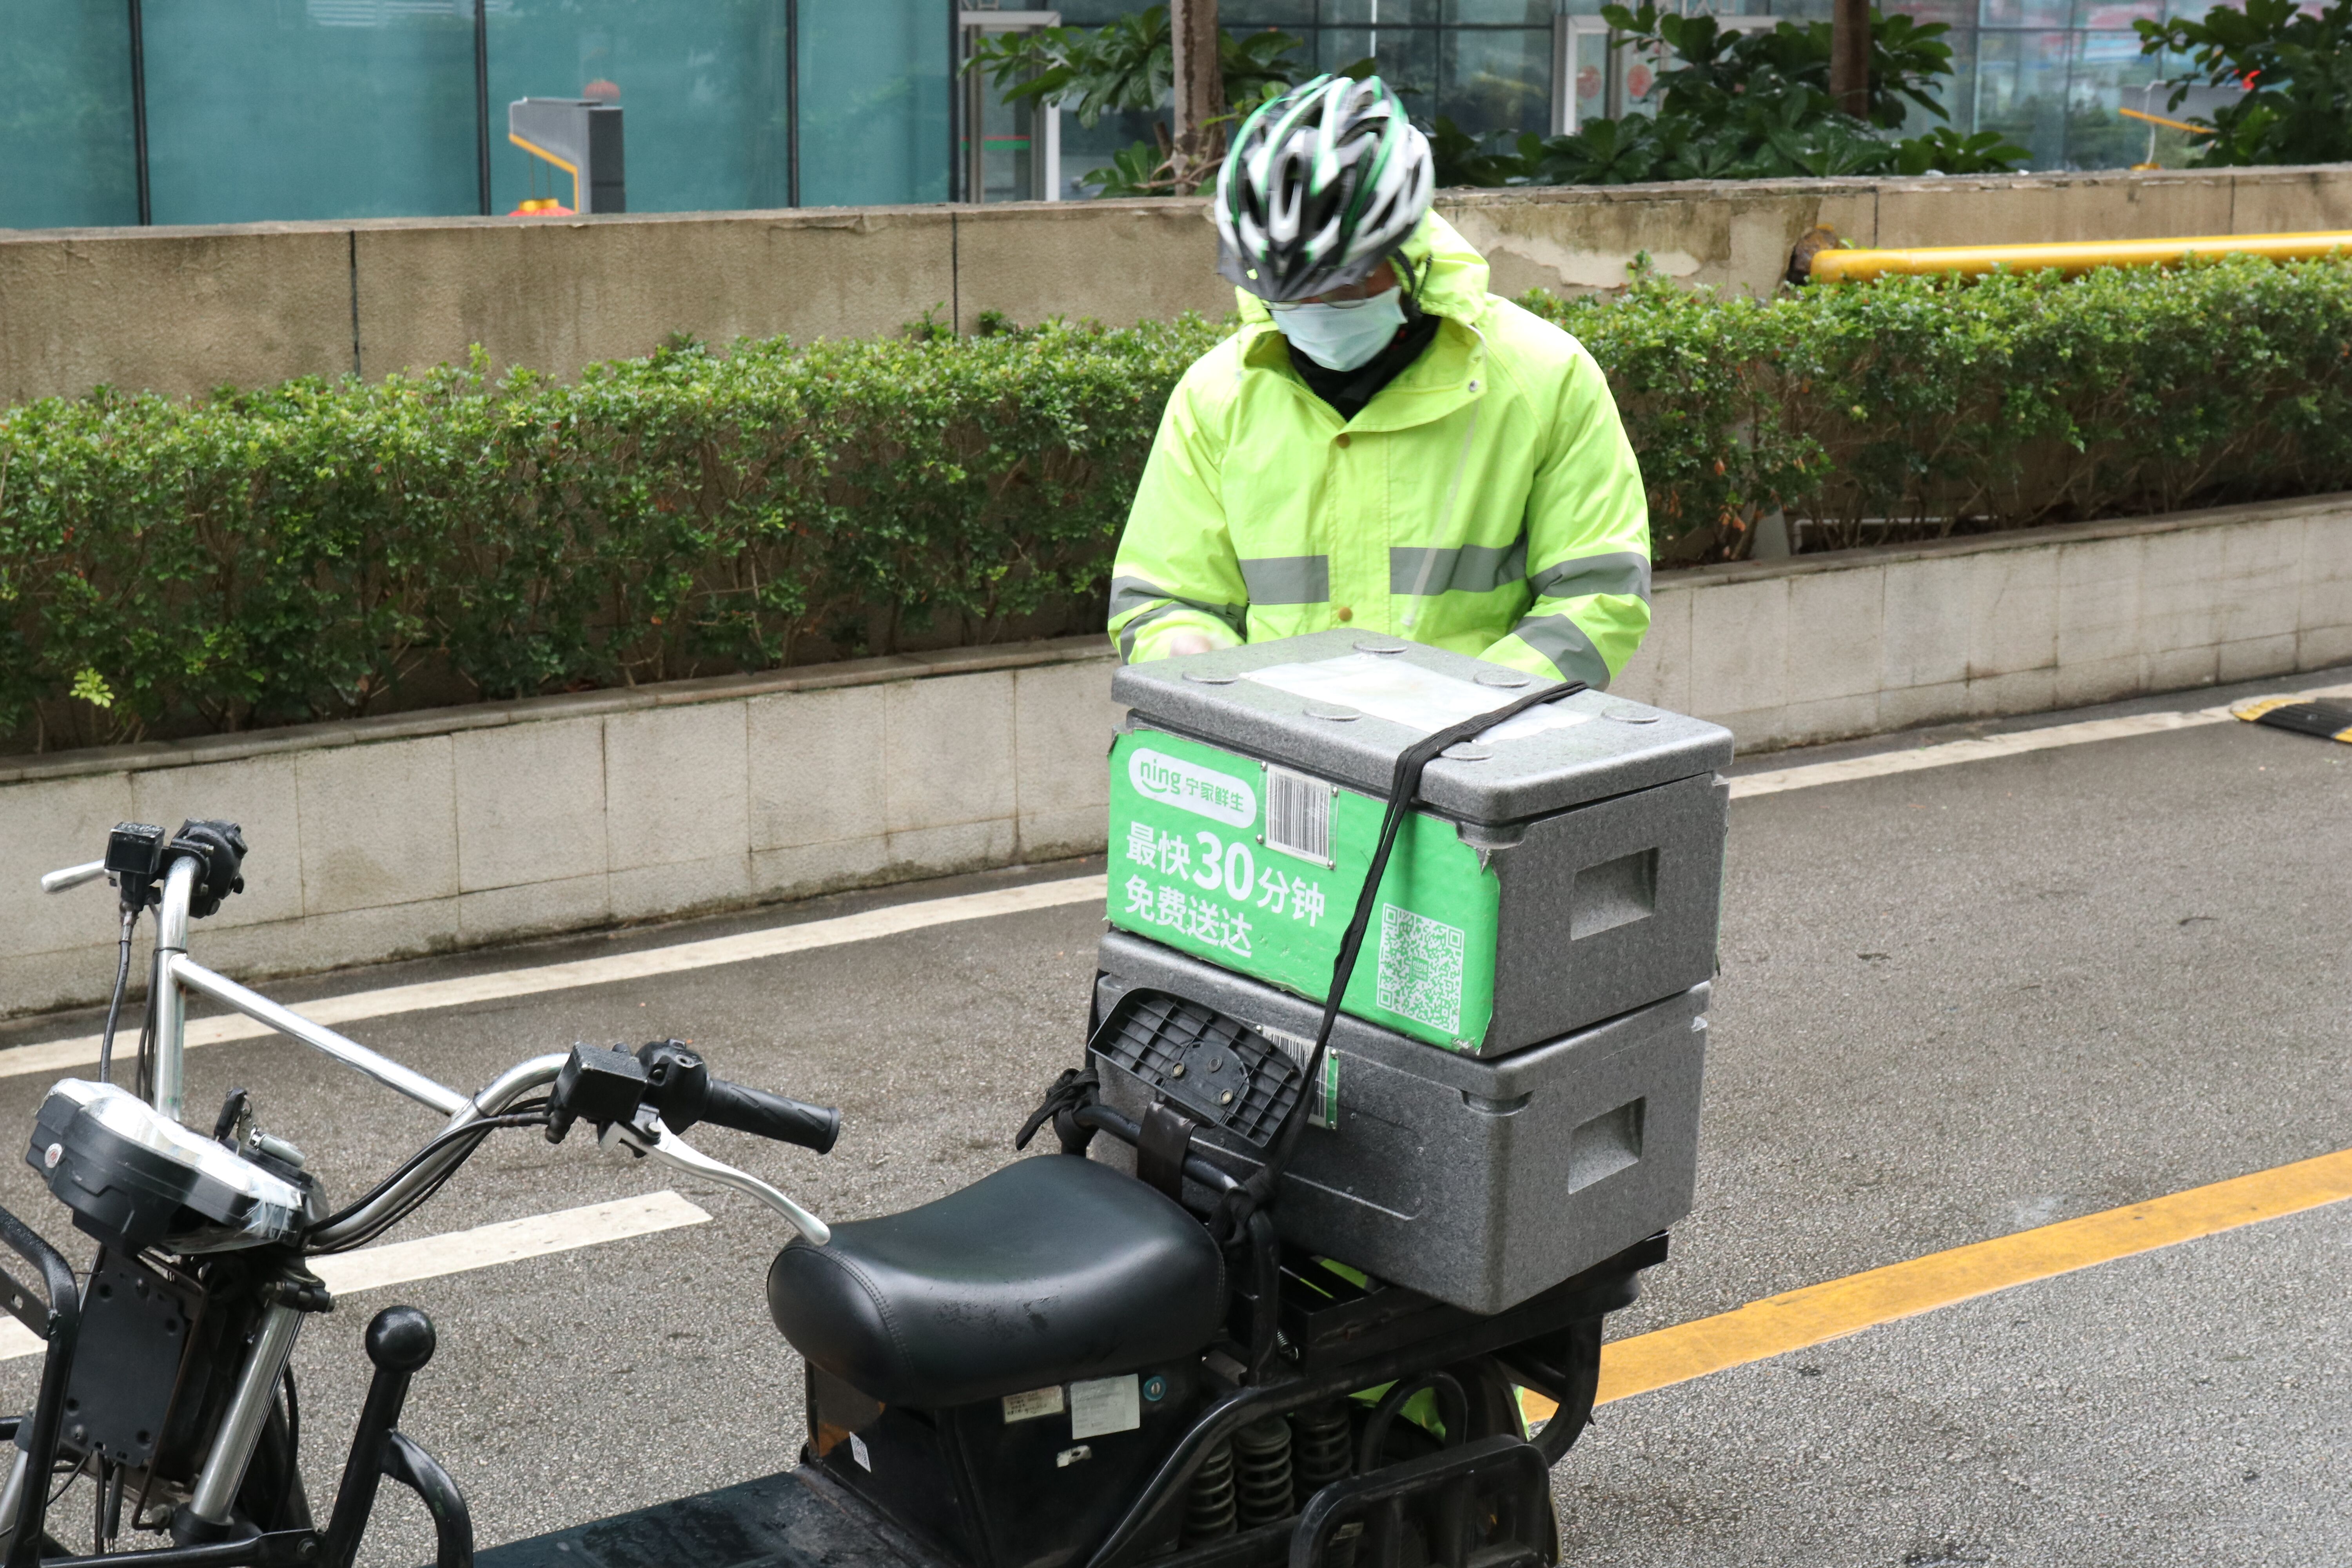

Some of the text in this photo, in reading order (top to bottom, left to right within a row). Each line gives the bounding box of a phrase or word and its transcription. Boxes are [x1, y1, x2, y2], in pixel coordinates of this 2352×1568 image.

[1141, 759, 1244, 813] ning 宁家鲜生
[1126, 822, 1325, 927] 最快30分钟
[1125, 875, 1252, 958] 免费送达
[1413, 960, 1427, 972] ning
